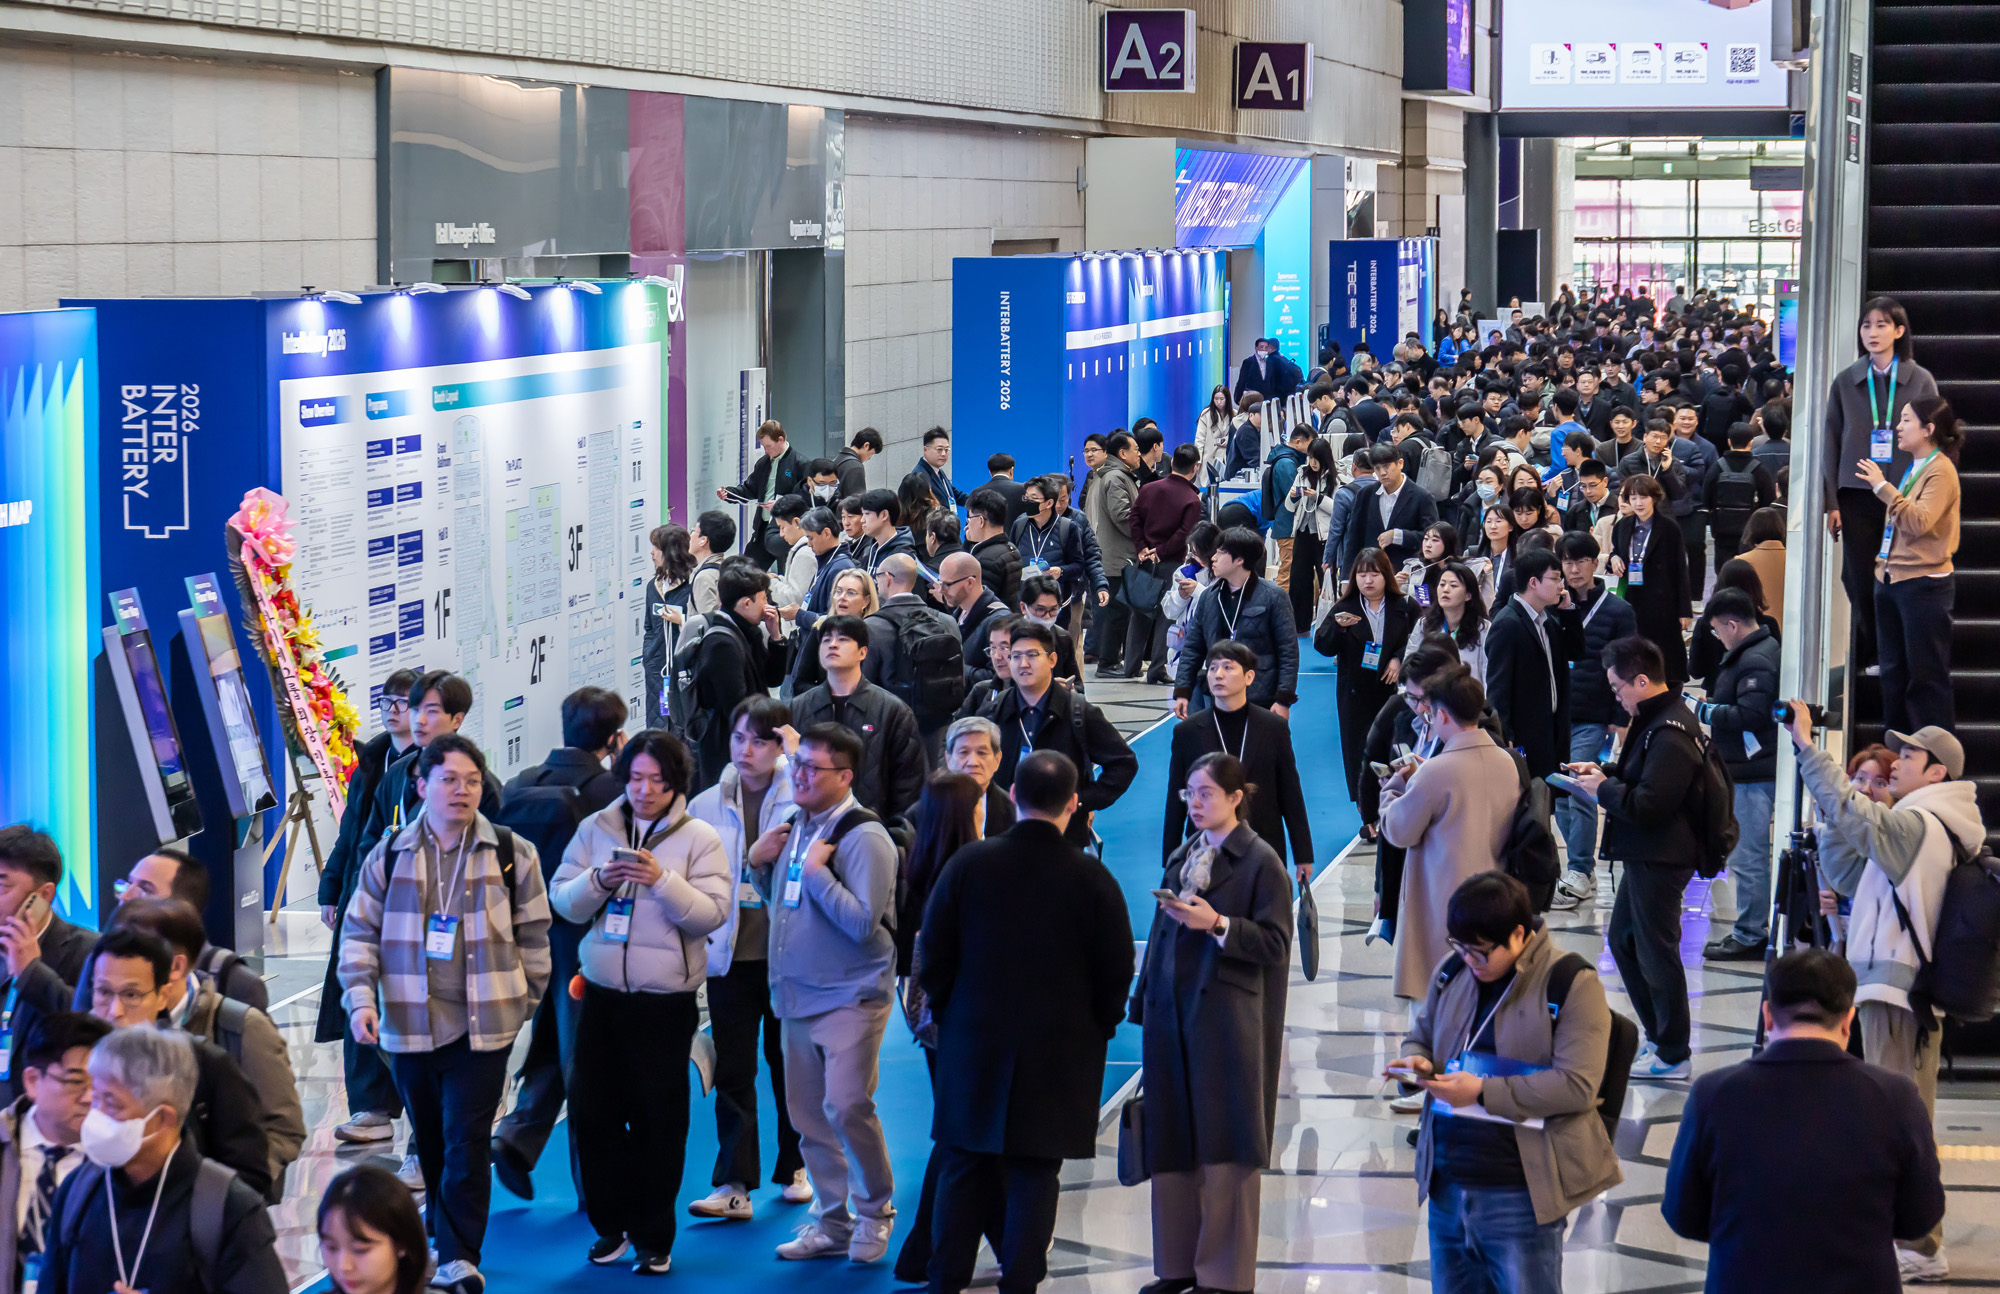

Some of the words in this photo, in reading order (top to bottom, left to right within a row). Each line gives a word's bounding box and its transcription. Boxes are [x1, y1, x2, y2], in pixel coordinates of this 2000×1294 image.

[1110, 23, 1182, 79] A2
[1243, 52, 1299, 101] A1
[1749, 219, 1782, 233] East
[1369, 260, 1378, 313] INTERBATTERY
[1000, 291, 1010, 376] INTERBATTERY
[1349, 297, 1358, 329] 2026
[1369, 314, 1378, 335] 2026
[328, 328, 346, 351] 2026
[181, 383, 200, 433] 2026
[1000, 380, 1010, 410] 2026
[121, 385, 149, 498] BATTERY
[151, 385, 178, 464] INTER
[568, 524, 583, 572] 3F
[434, 587, 451, 640] 1F
[530, 635, 546, 685] 2F
